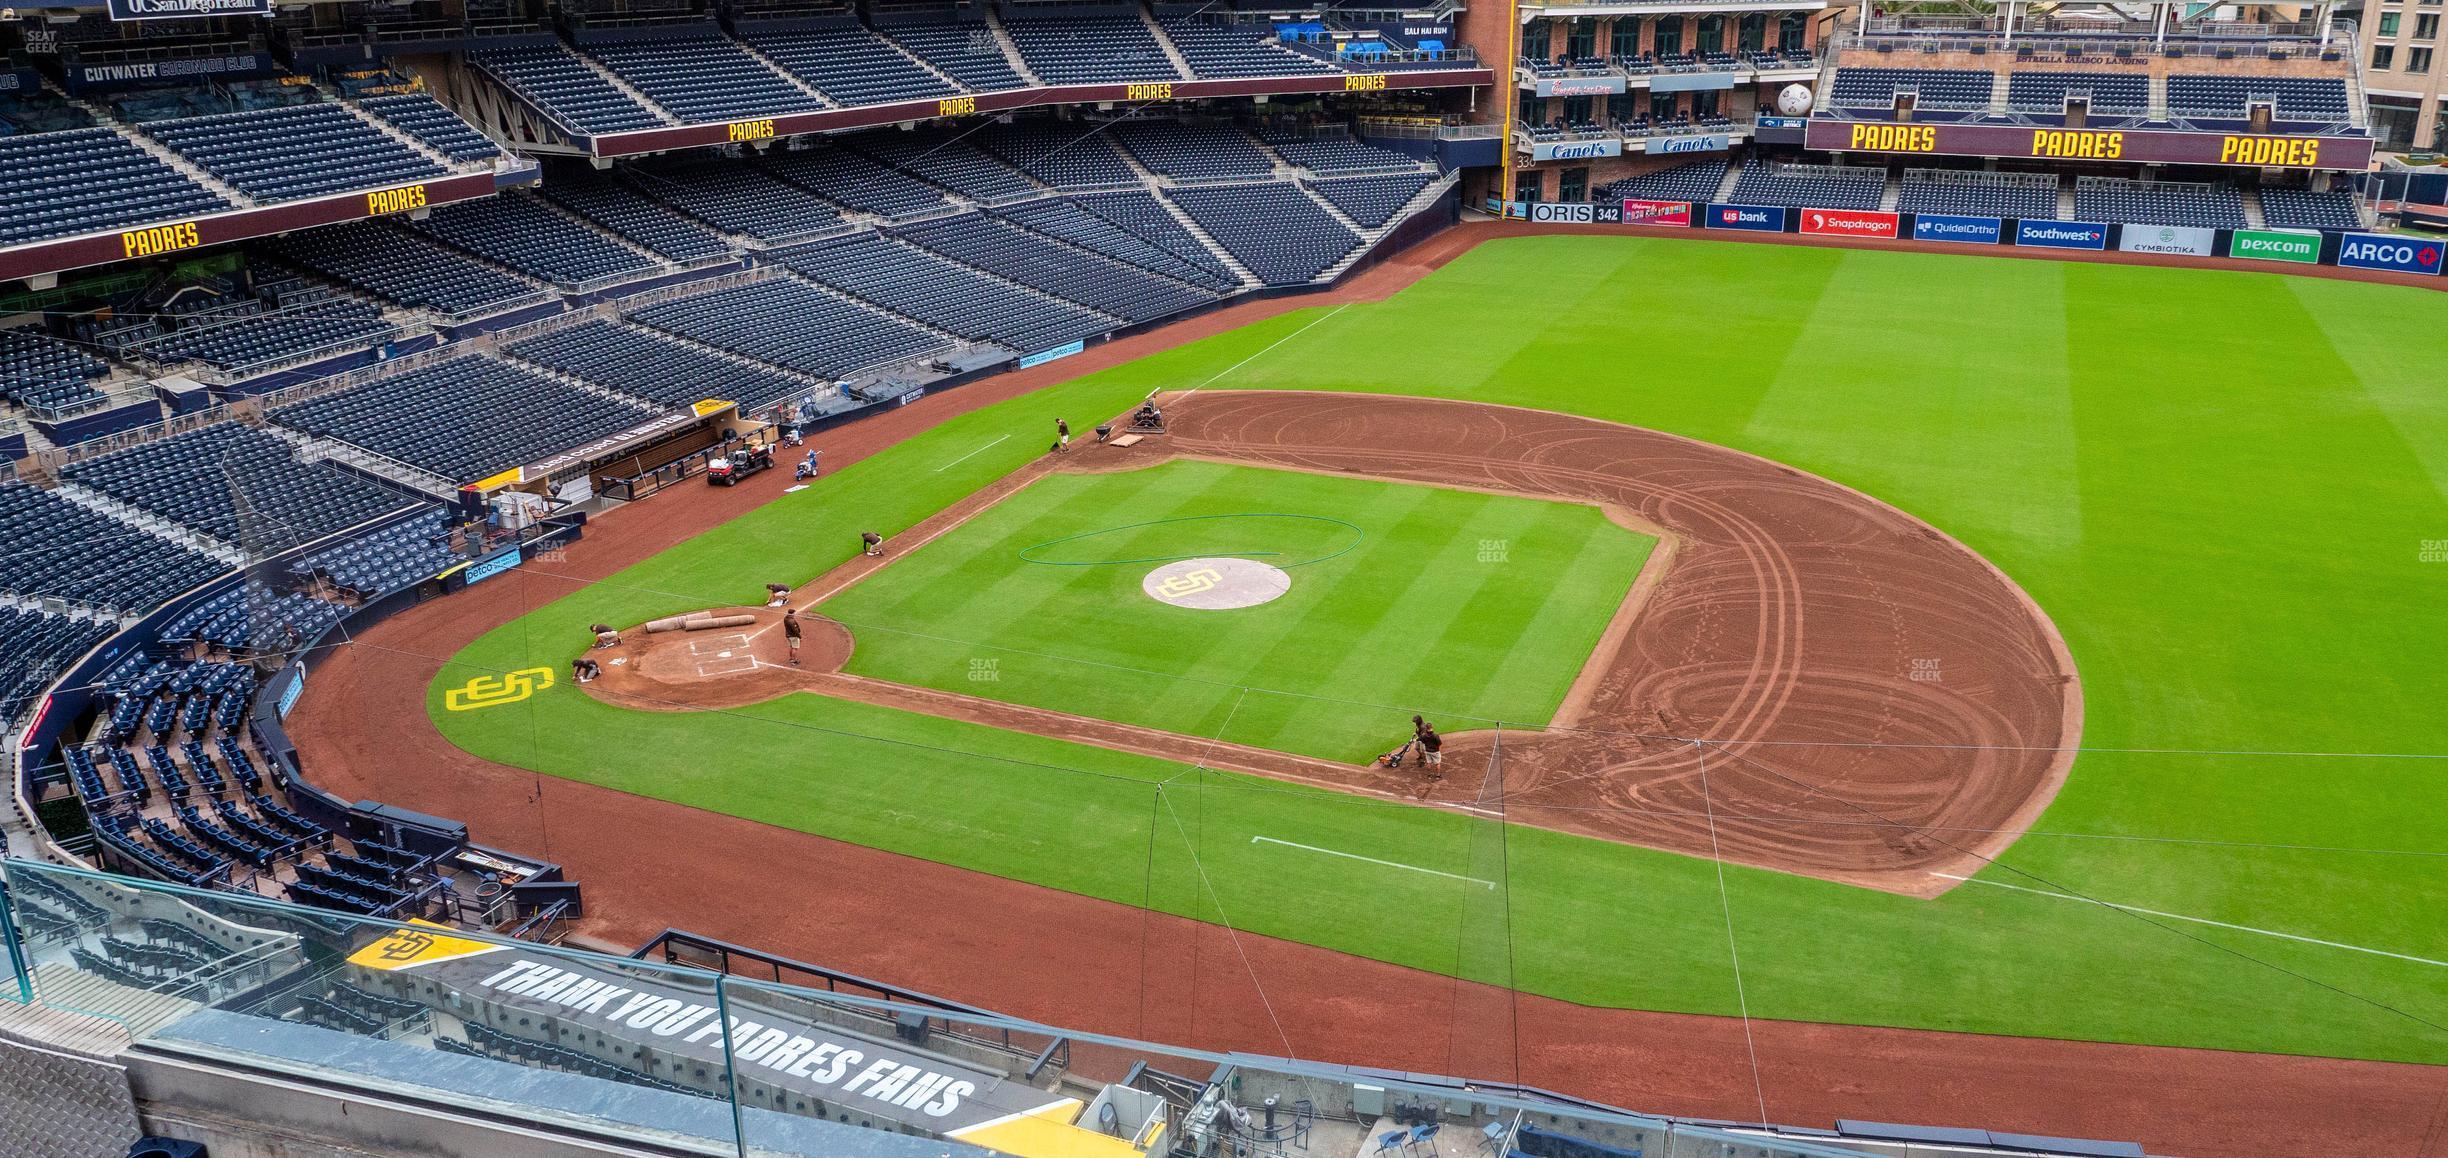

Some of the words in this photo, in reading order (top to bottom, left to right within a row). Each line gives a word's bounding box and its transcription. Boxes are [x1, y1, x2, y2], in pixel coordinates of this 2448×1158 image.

[84, 64, 156, 82] CUTWATER
[160, 58, 225, 76] CORONADO
[227, 56, 256, 70] CLUB
[2016, 55, 2062, 64] ESTRELLA
[2064, 56, 2104, 65] JALISCO
[2106, 57, 2148, 66] LANDING
[1346, 75, 1386, 91] PADRES
[1128, 84, 1172, 100] PADRES
[940, 98, 975, 116] PADRES
[729, 120, 774, 141] PADRES
[1851, 124, 1936, 152] PADRES
[1551, 143, 1606, 159] Canel's
[1662, 136, 1714, 152] Canel's
[2032, 130, 2123, 159] PADRES
[2220, 136, 2319, 166] PADRES
[368, 186, 426, 214] PADRES
[1536, 206, 1591, 221] ORIS
[1598, 208, 1618, 221] 342
[1828, 218, 1891, 230] Snapdragon
[1934, 223, 1995, 234] QuidelOrtho
[122, 223, 199, 258] PADRES
[2023, 227, 2090, 241] Southwest
[2134, 244, 2195, 254] CYMBIOTIKA
[2343, 242, 2414, 264] ARCO
[467, 564, 493, 582] petco
[480, 960, 632, 1014] THANK
[606, 992, 718, 1036] YOU
[683, 1013, 864, 1084] PADRES
[841, 1058, 976, 1117] FANS
